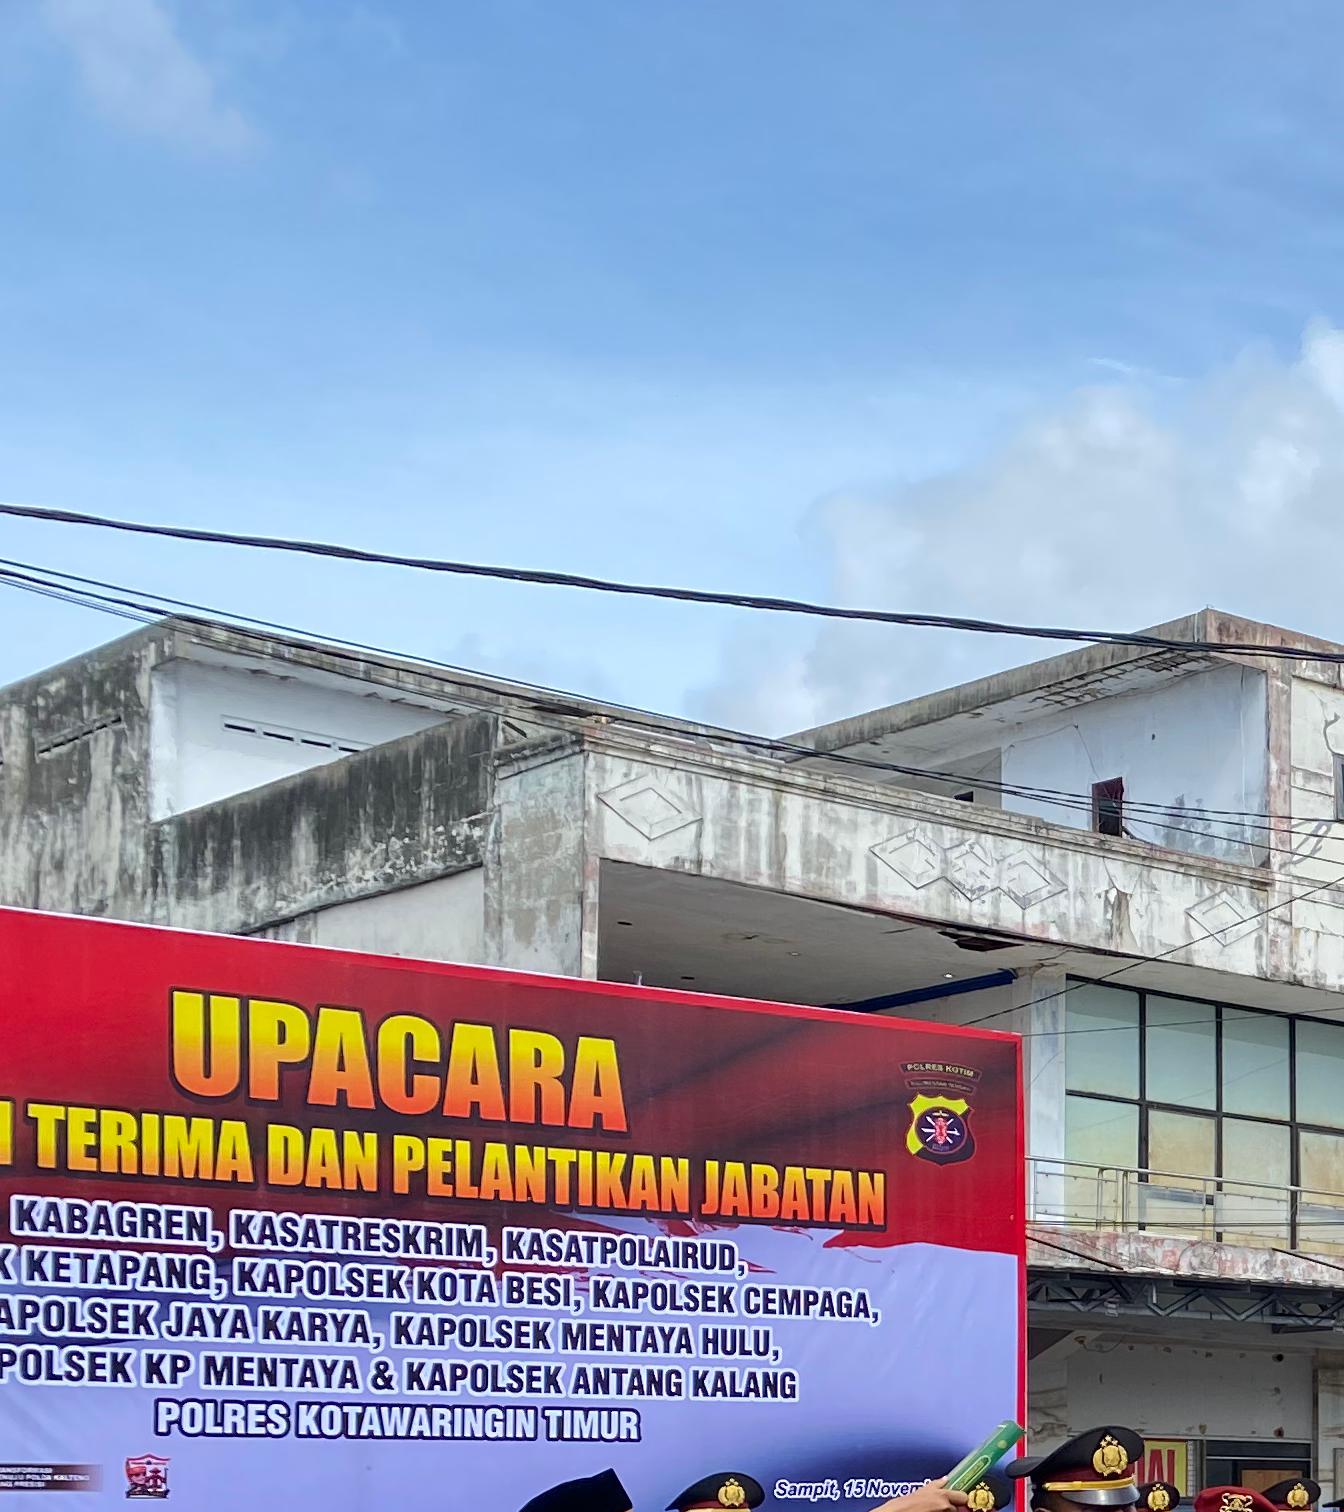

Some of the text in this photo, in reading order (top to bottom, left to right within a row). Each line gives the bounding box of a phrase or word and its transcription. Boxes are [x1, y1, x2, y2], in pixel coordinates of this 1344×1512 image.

[171, 988, 629, 1134] UPACARA
[27, 1102, 254, 1184] TERIMA
[267, 1122, 378, 1193] DAN
[393, 1134, 690, 1214] PELANTIKAN
[701, 1159, 886, 1226] JABATAN
[14, 1199, 746, 1277] KABAGREN, KASATRESKRIM, KASATPOLAIRUD,
[26, 1249, 225, 1297] KETAPANG,
[238, 1261, 407, 1299] KAPOLSEK
[417, 1271, 496, 1303] KOTA
[506, 1274, 582, 1313] BESI,
[594, 1280, 735, 1314] KAPOLSEK
[744, 1287, 880, 1325] CEMPAGA,
[166, 1306, 250, 1339] JAYA
[262, 1310, 381, 1351] KARYA,
[395, 1315, 551, 1350] KAPOLSEK
[562, 1323, 692, 1355] MENTAYA
[702, 1328, 780, 1362] HULU,
[145, 1353, 191, 1384] KP
[204, 1355, 359, 1390] MENTAYA
[370, 1361, 393, 1391] &
[407, 1361, 563, 1395] KAPOLSEK
[571, 1367, 683, 1398] ANTANG
[692, 1369, 796, 1399] KALANG
[156, 1400, 641, 1441] POLRES KOTAWARINGIN TIMUR
[775, 1479, 840, 1501] Sampit,
[843, 1479, 864, 1498] 15
